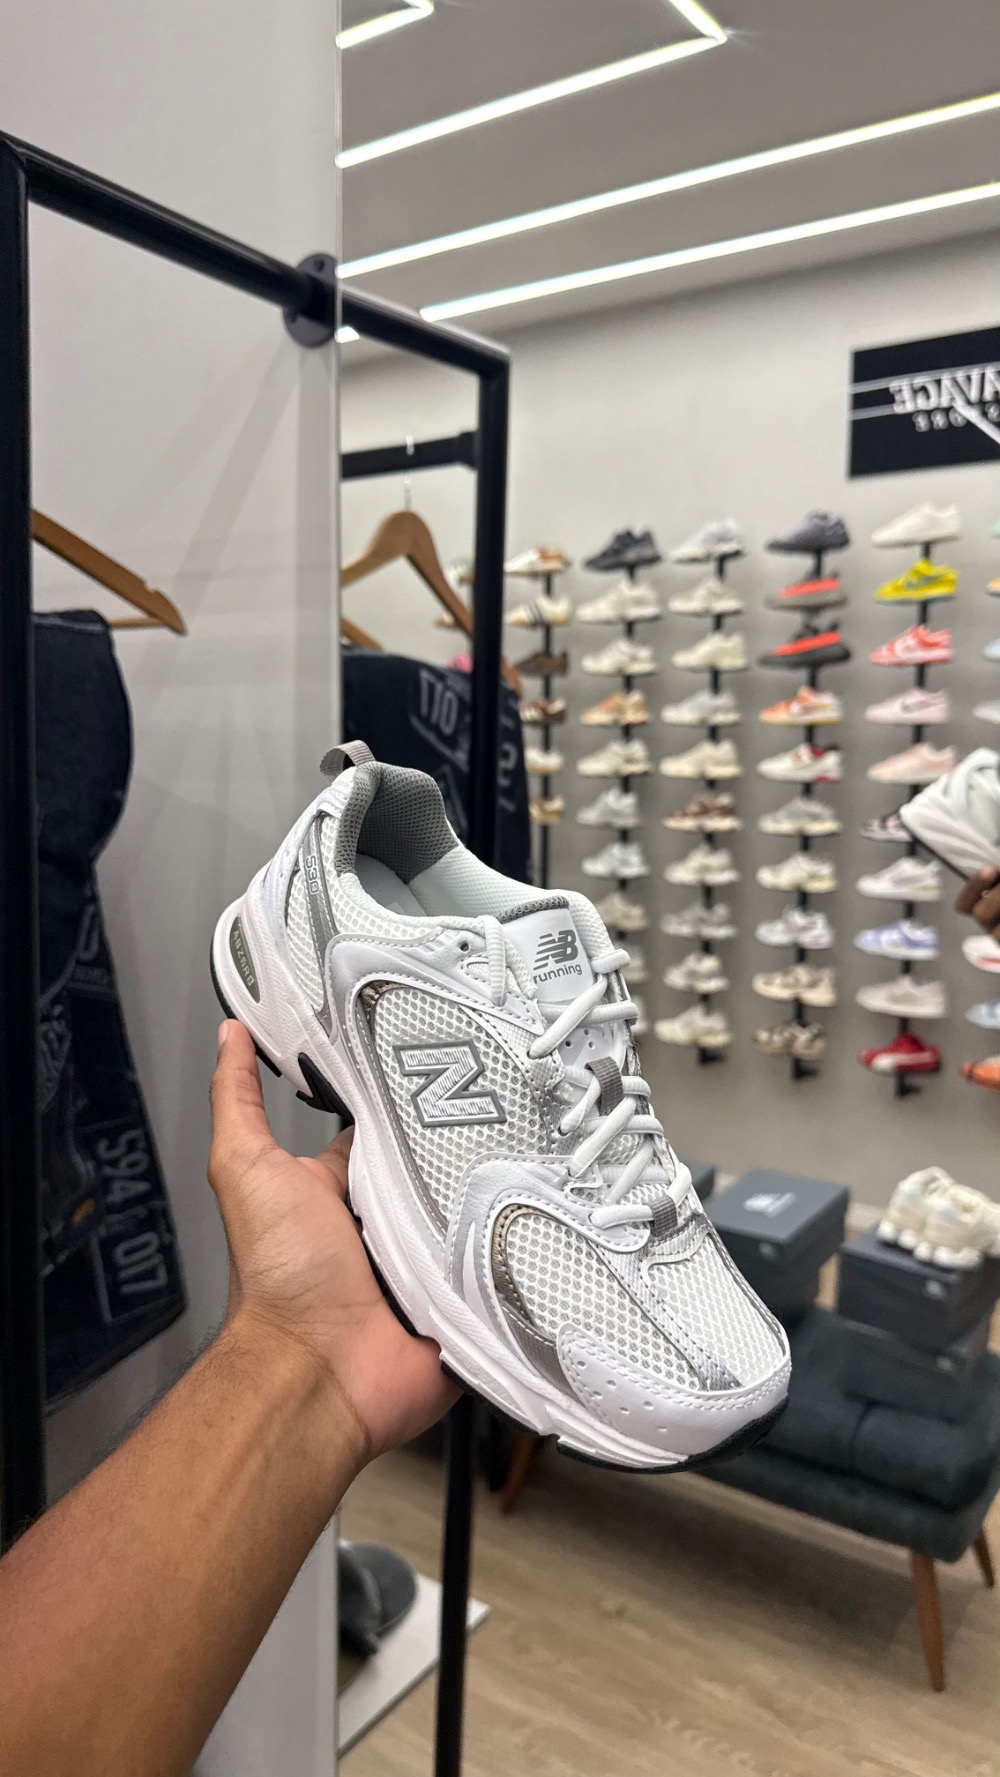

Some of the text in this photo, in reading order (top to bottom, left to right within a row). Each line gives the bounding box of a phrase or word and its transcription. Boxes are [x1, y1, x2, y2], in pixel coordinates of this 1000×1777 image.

[304, 855, 319, 894] 530
[533, 964, 582, 984] running
[392, 1039, 507, 1127] N
